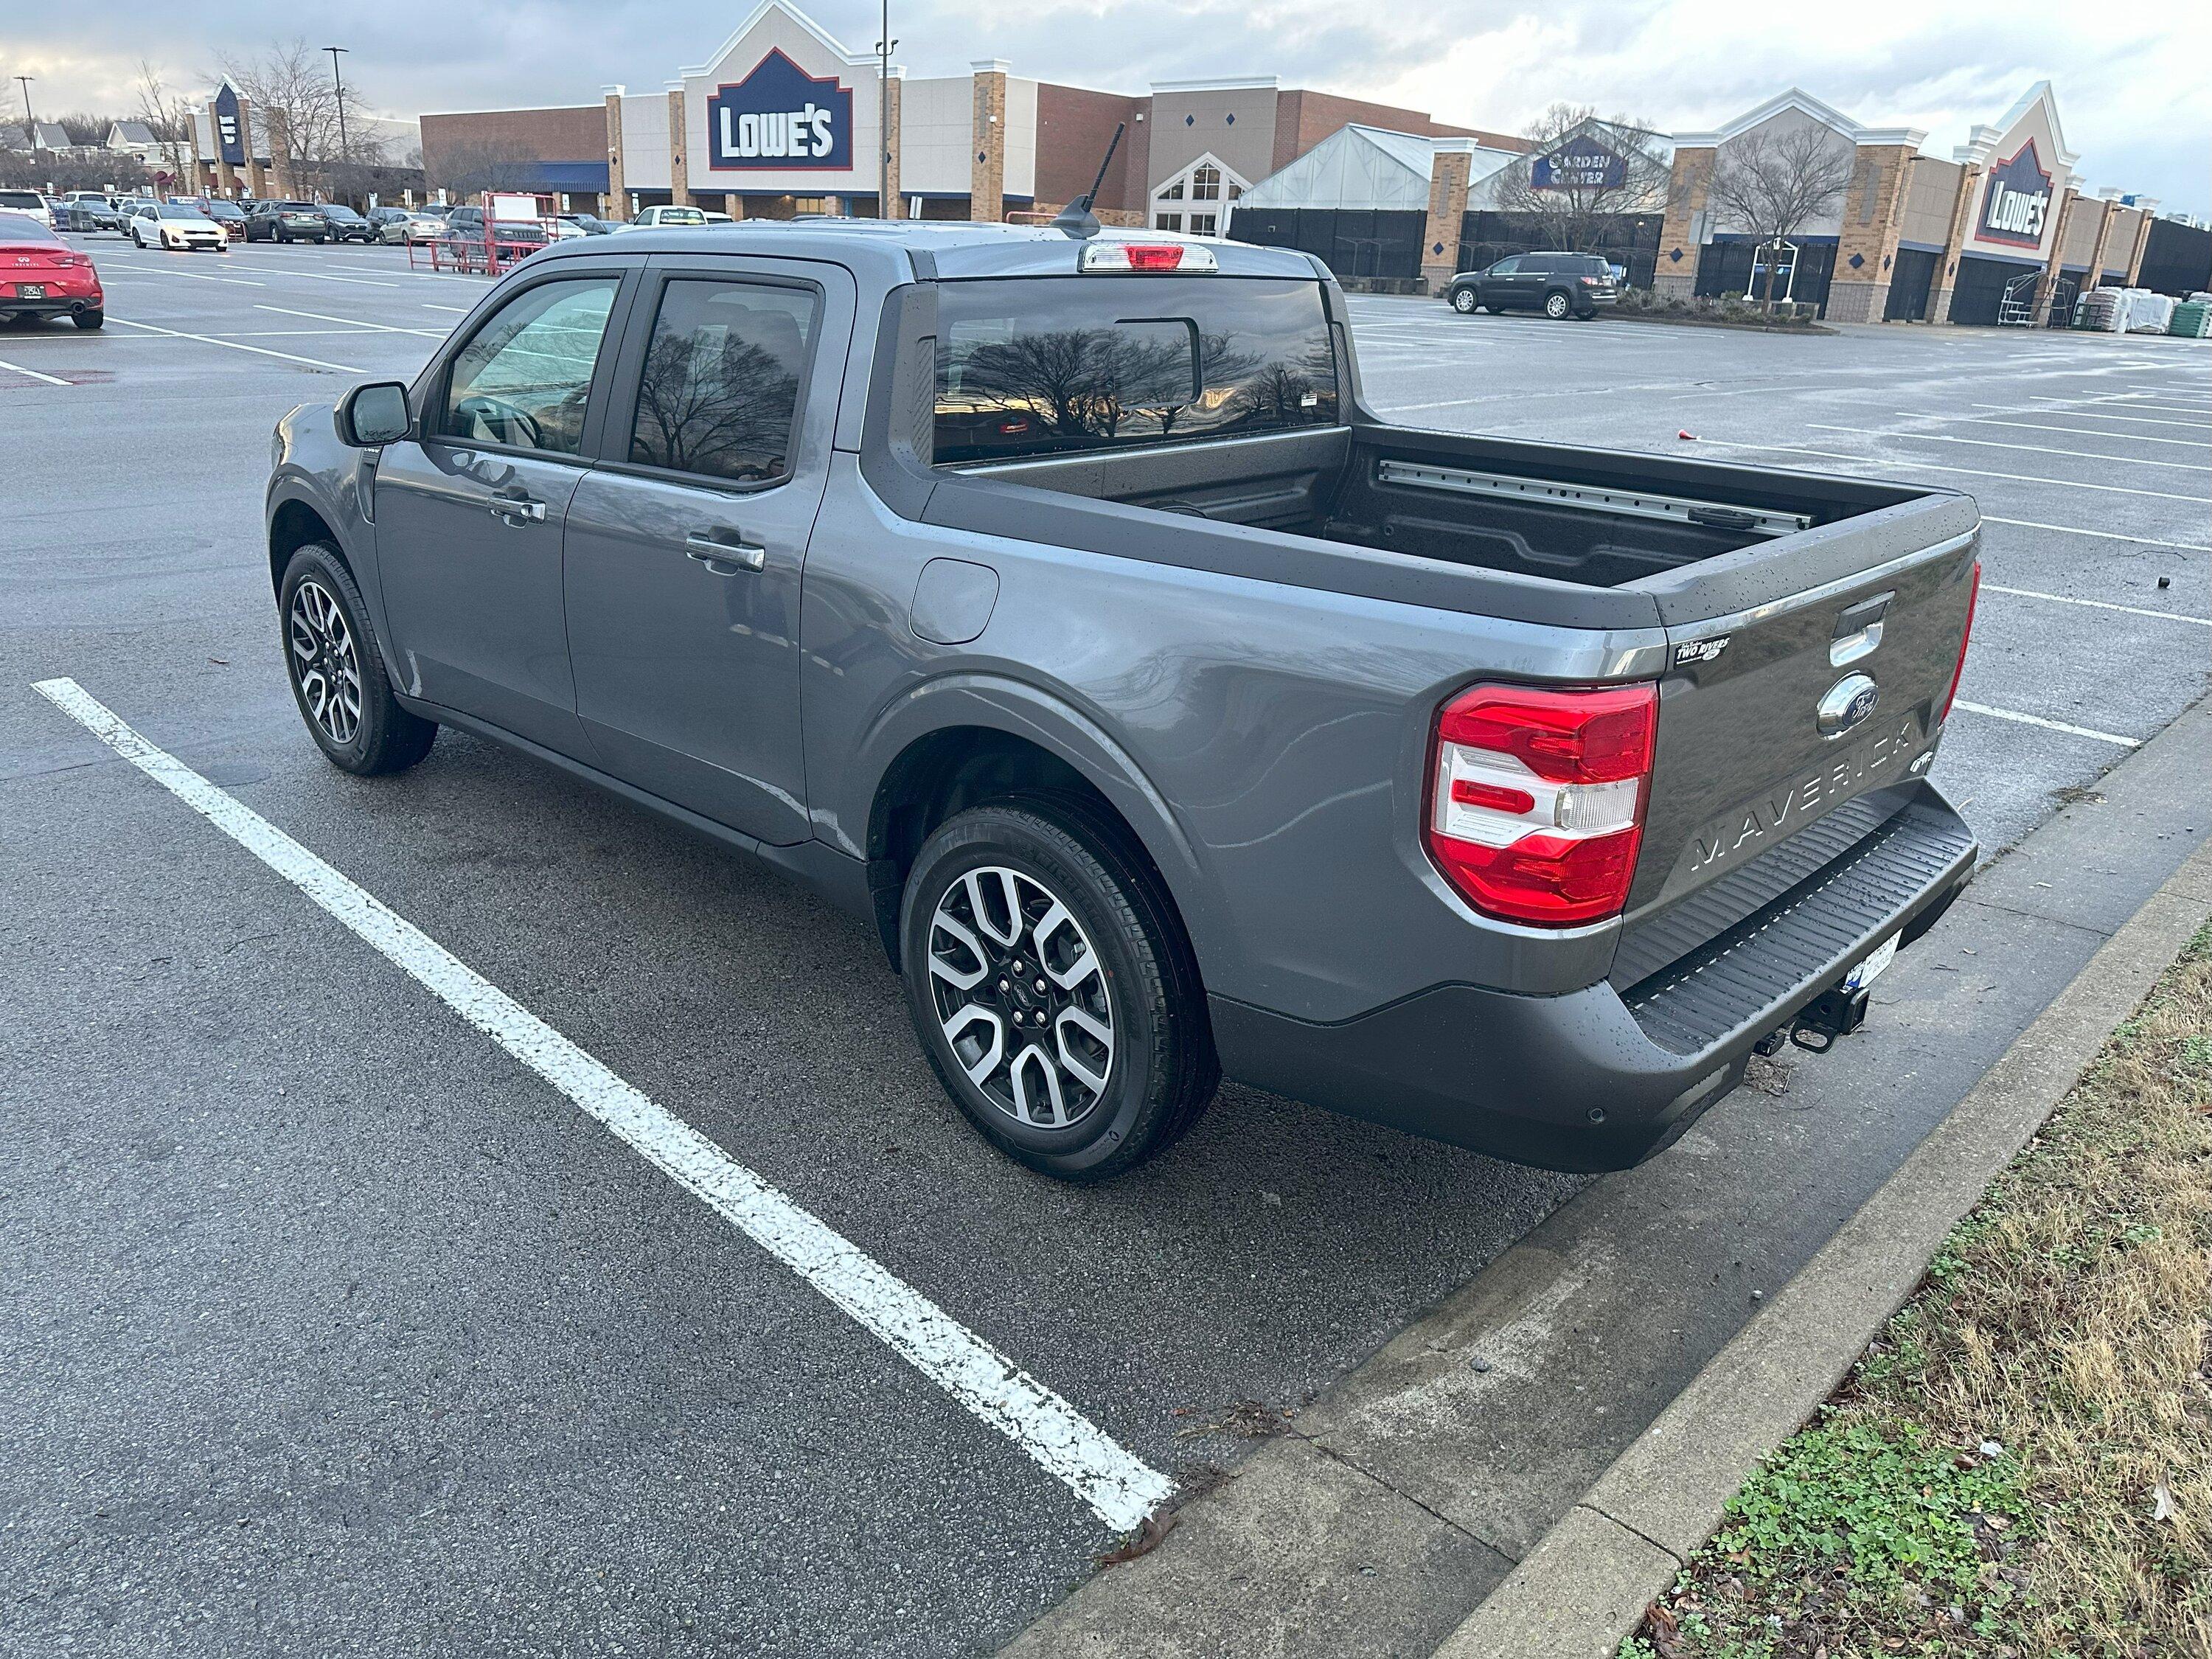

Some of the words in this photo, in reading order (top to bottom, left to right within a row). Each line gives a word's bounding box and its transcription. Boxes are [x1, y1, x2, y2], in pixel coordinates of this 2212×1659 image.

[720, 102, 834, 158] LOWE'S
[1548, 153, 1611, 169] GARDEN
[1550, 168, 1604, 184] CENTER
[1986, 180, 2049, 236] LOWE'S
[1677, 646, 1698, 660] TWO
[1698, 637, 1731, 655] RIVERS
[1852, 692, 1876, 719] Ford
[1691, 722, 1910, 872] MAVERICK
